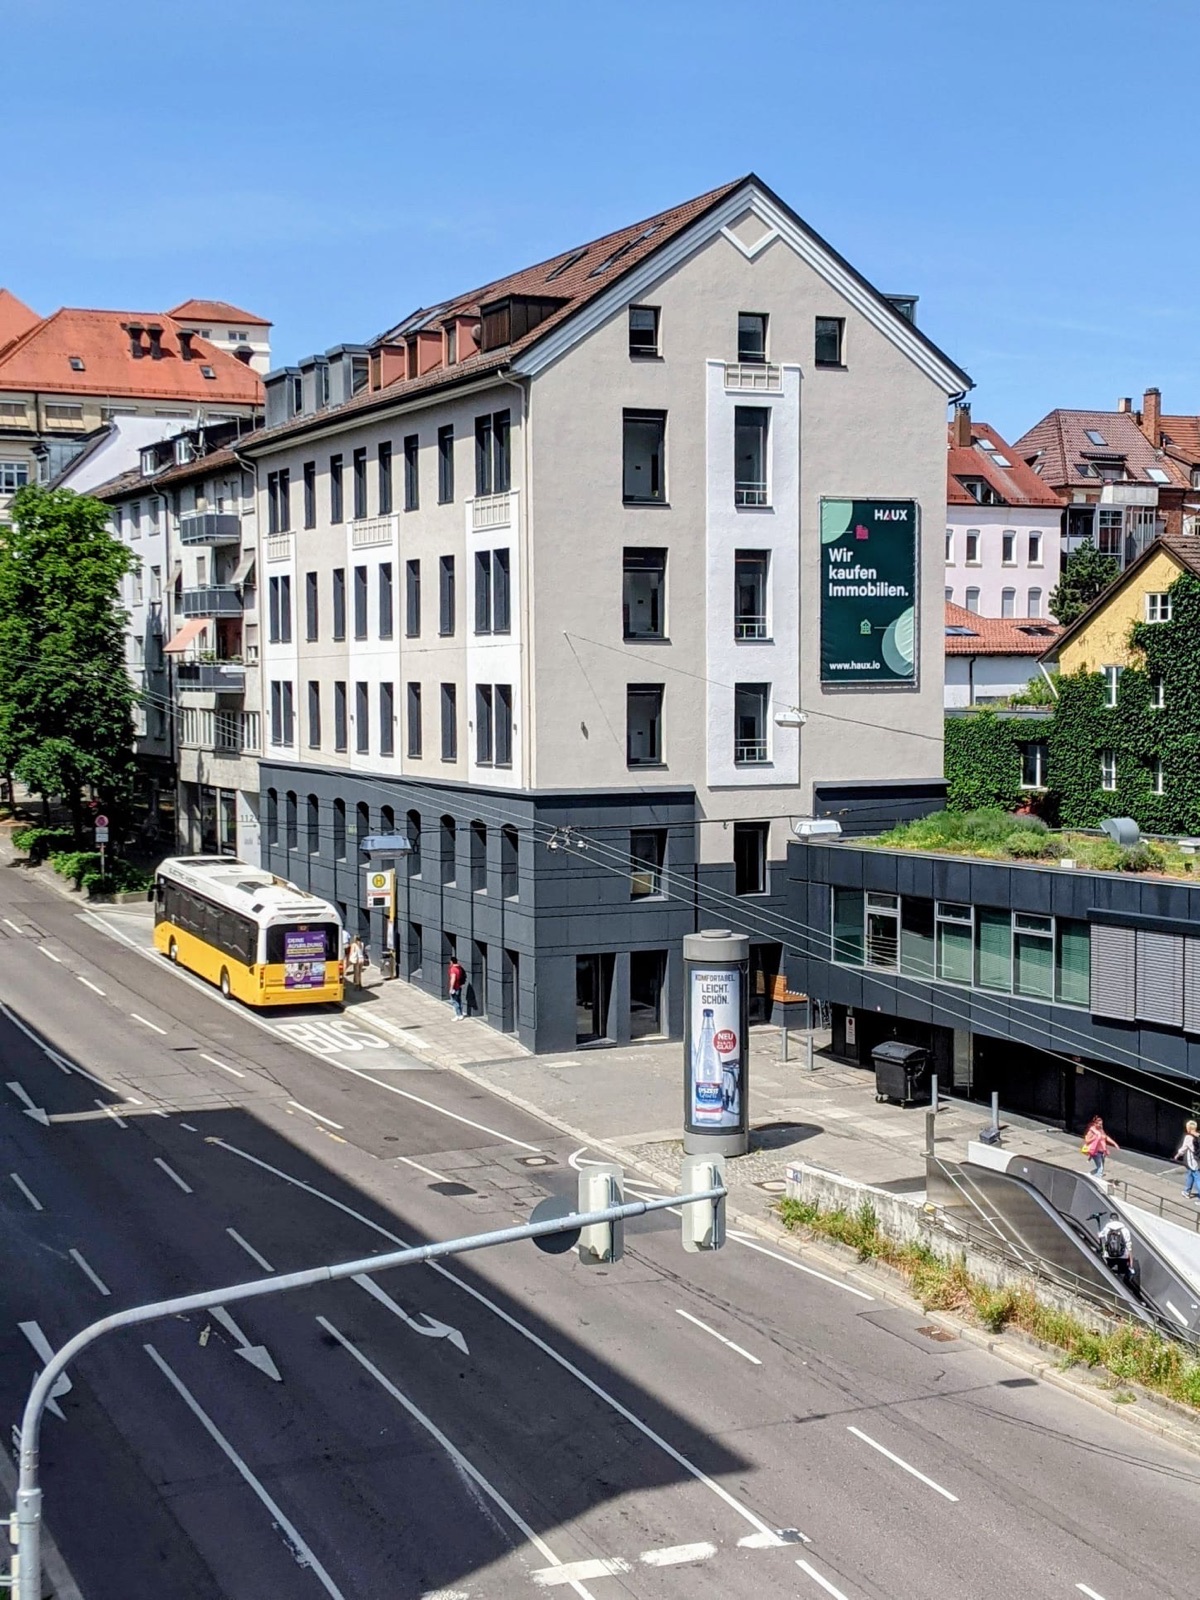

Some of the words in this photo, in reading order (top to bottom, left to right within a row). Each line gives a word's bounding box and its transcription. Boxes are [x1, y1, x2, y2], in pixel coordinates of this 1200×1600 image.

[874, 509, 908, 521] HAUX
[828, 548, 853, 562] Wir
[829, 564, 877, 580] kaufen
[829, 582, 909, 597] Immobilien.
[829, 660, 881, 670] www.haux.io
[702, 983, 729, 993] LEICHT.
[702, 994, 729, 1005] SCHÖN.
[275, 1020, 390, 1054] BUS
